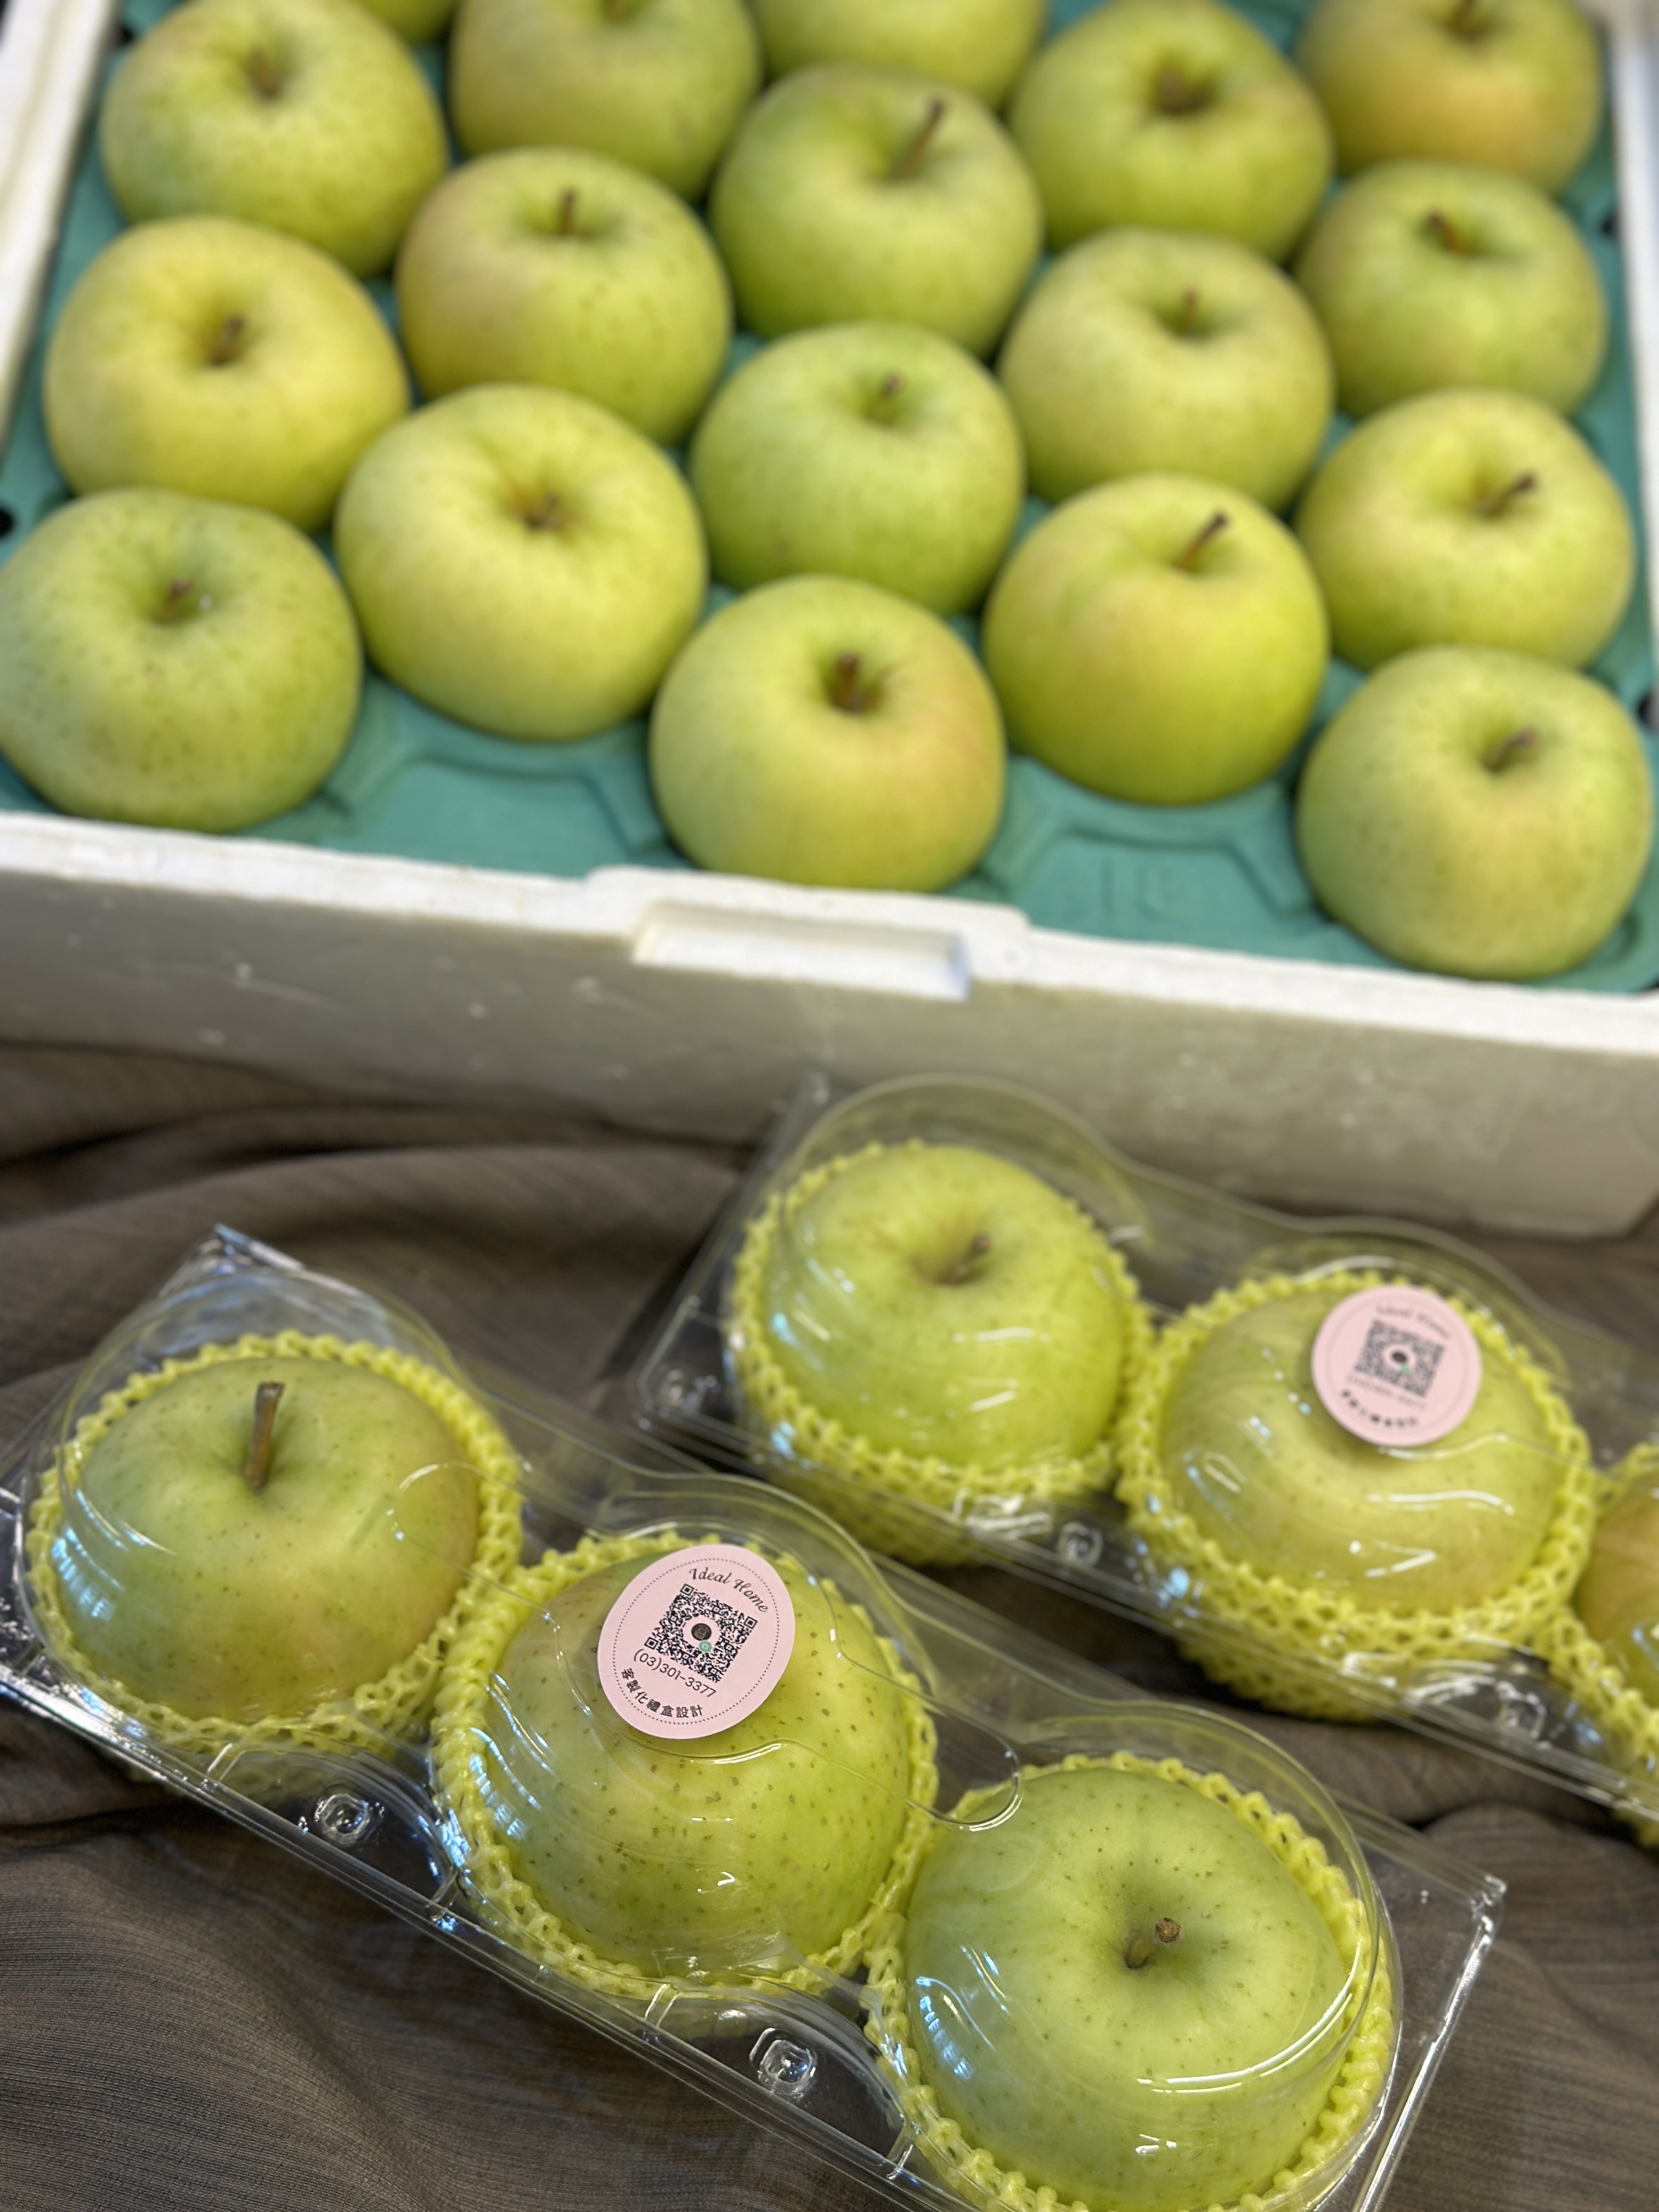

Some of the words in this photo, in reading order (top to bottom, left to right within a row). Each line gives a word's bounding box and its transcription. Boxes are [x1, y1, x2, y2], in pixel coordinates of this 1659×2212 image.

[689, 1567, 732, 1584] Ideal
[733, 1579, 768, 1612] Home
[621, 1668, 703, 1718] 客製化禮盒設計
[634, 1649, 716, 1697] (03)301-3377
